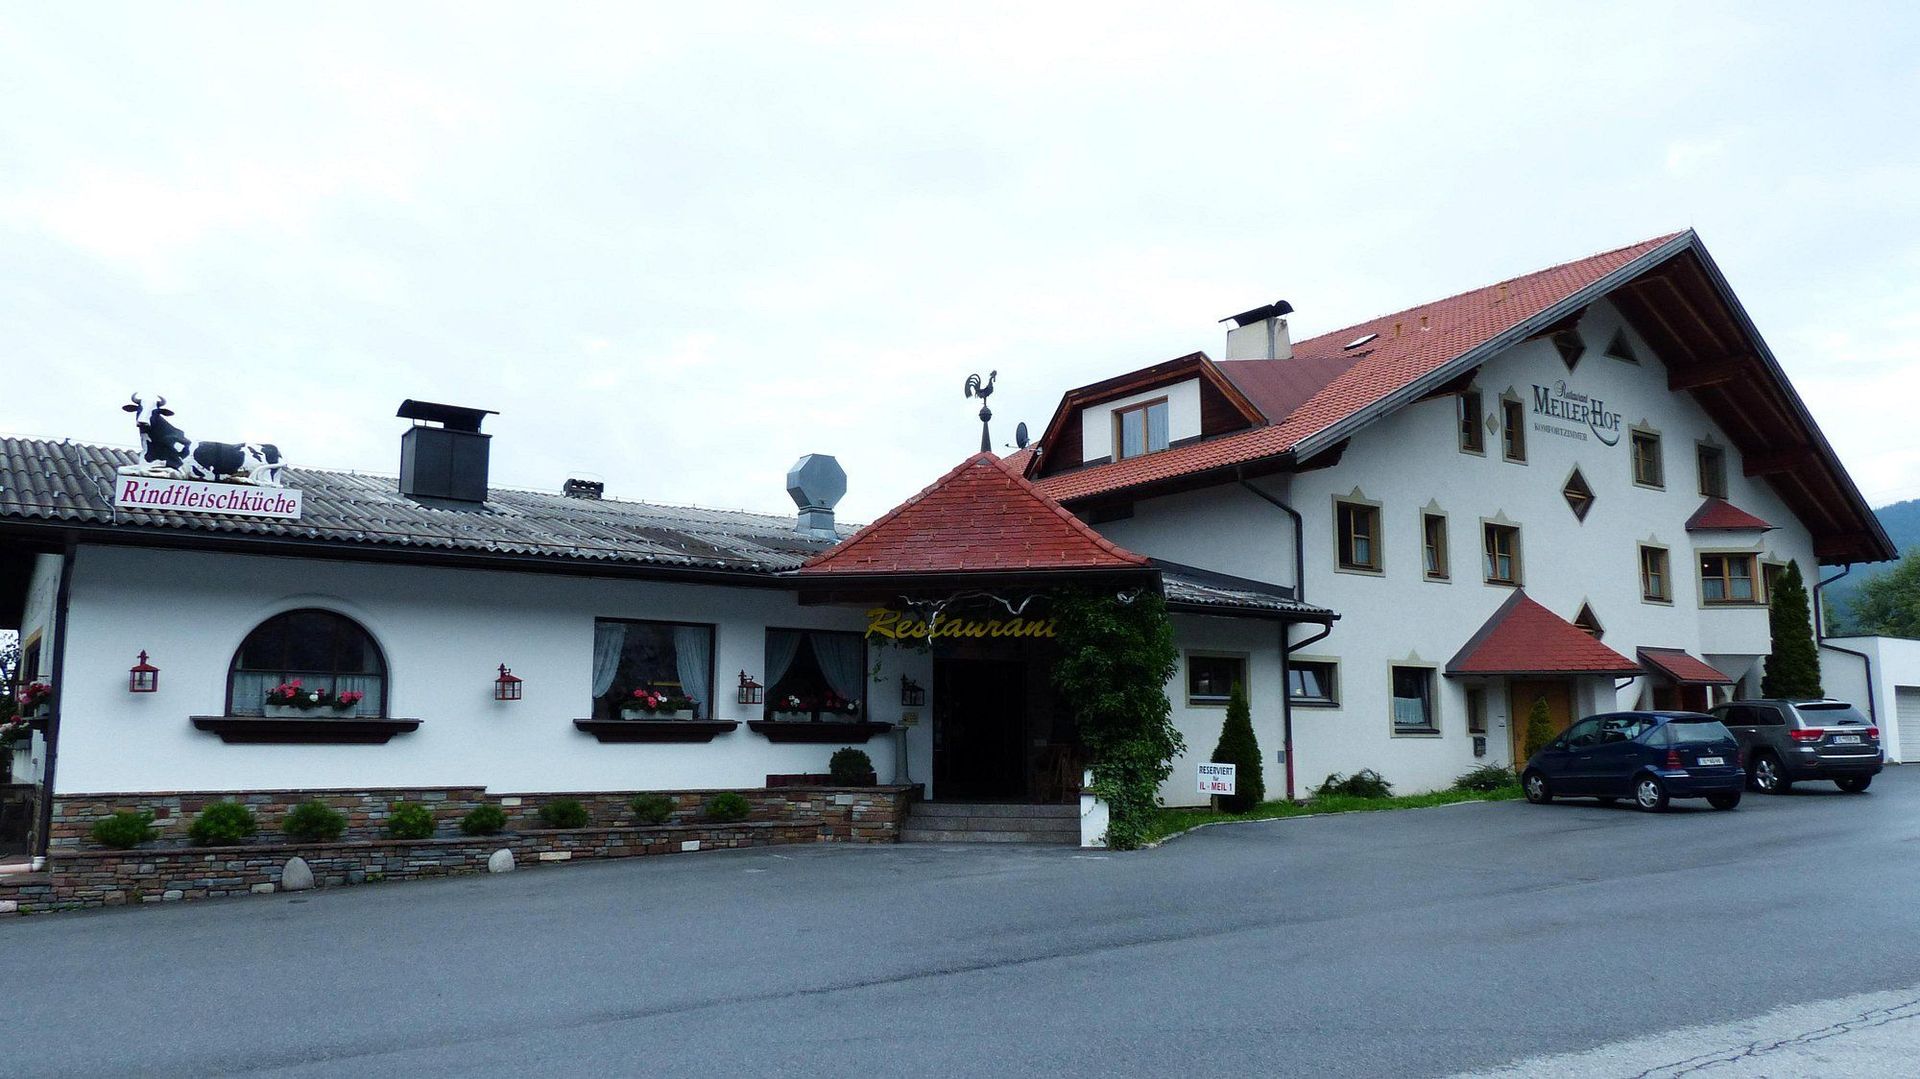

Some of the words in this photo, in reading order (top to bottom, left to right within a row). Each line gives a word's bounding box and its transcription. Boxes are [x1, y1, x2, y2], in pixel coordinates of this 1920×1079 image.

[120, 480, 296, 513] Rindfleischküche
[864, 607, 1057, 639] Restaurant
[1199, 765, 1233, 775] RESERVIERT
[1199, 781, 1206, 790] IL
[1210, 782, 1227, 791] MEIL
